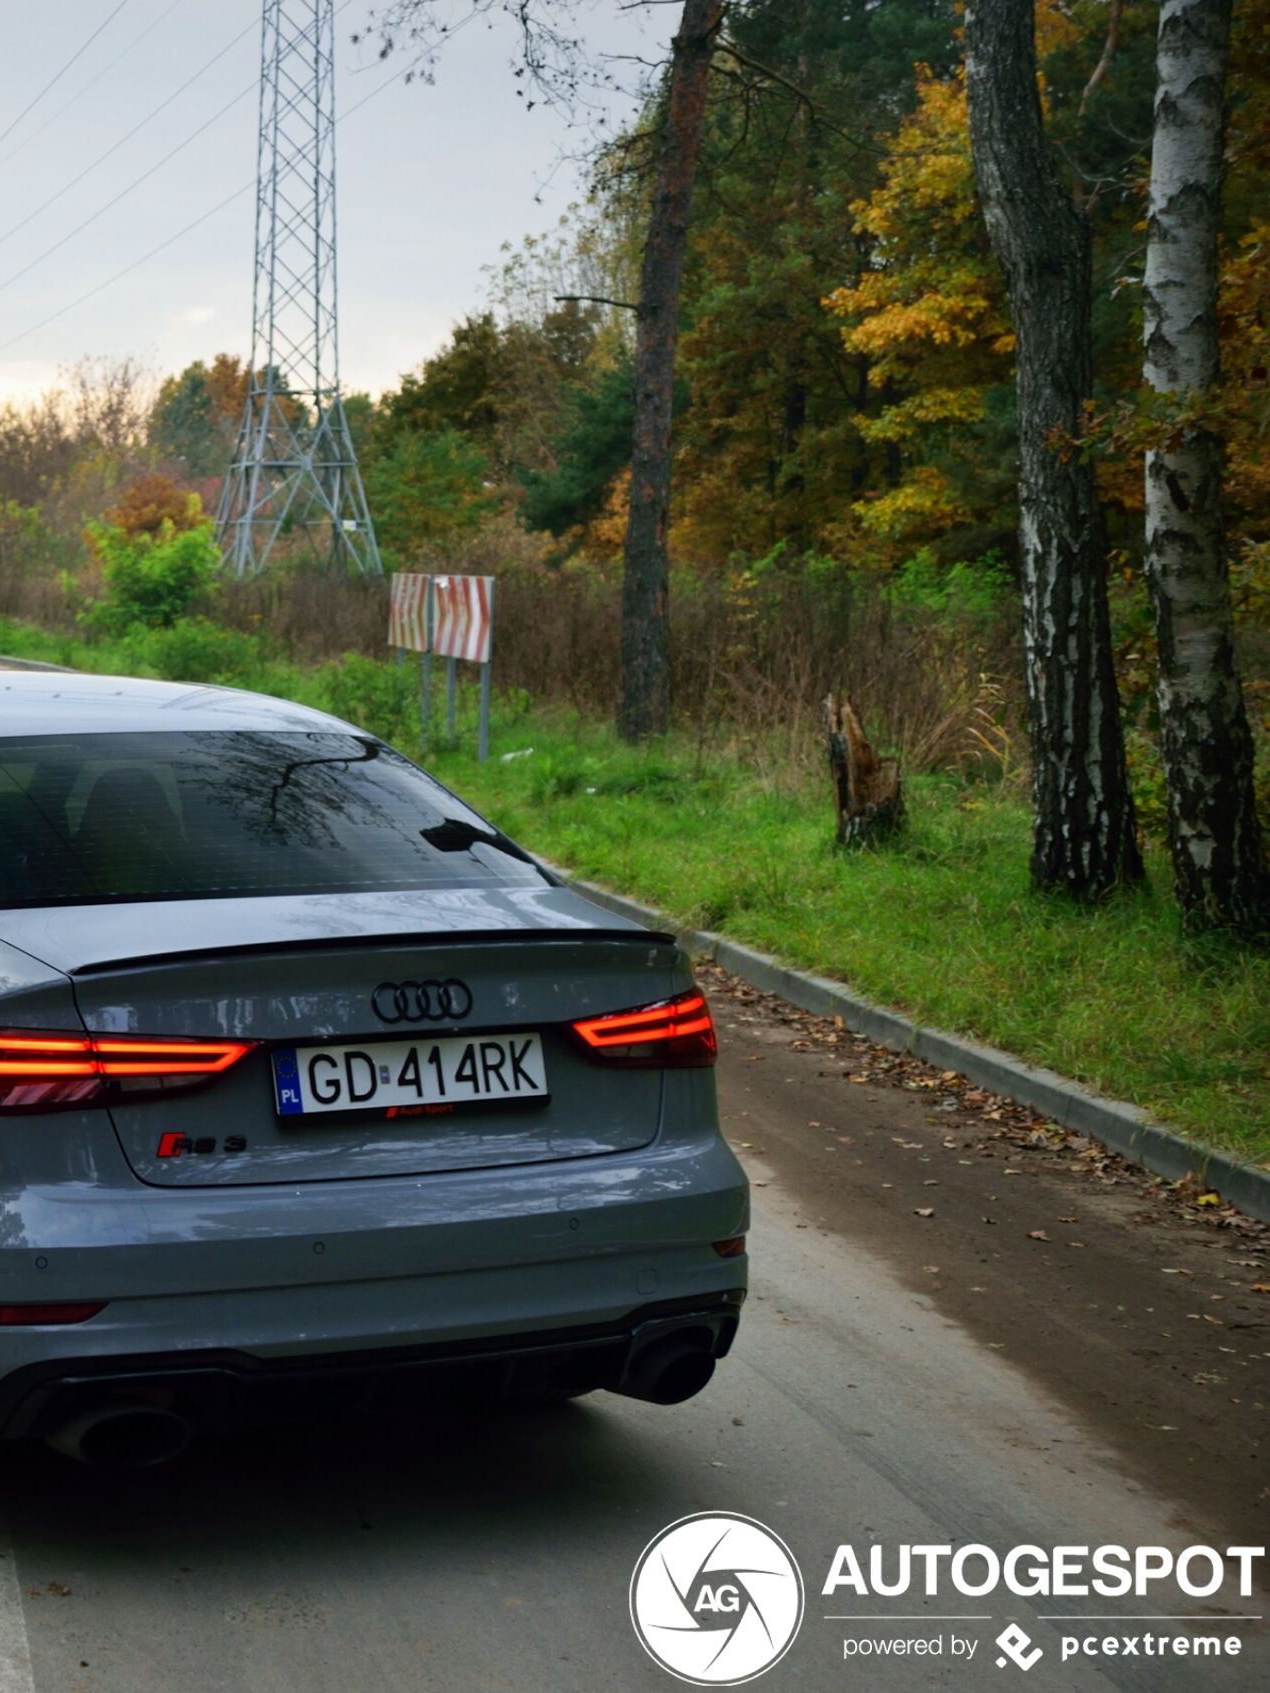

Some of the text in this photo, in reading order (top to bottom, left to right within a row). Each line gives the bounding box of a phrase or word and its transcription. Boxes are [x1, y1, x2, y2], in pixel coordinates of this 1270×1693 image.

[308, 1039, 539, 1104] GD 414RK
[281, 1089, 299, 1103] PL
[399, 1103, 454, 1115] Audi Sport
